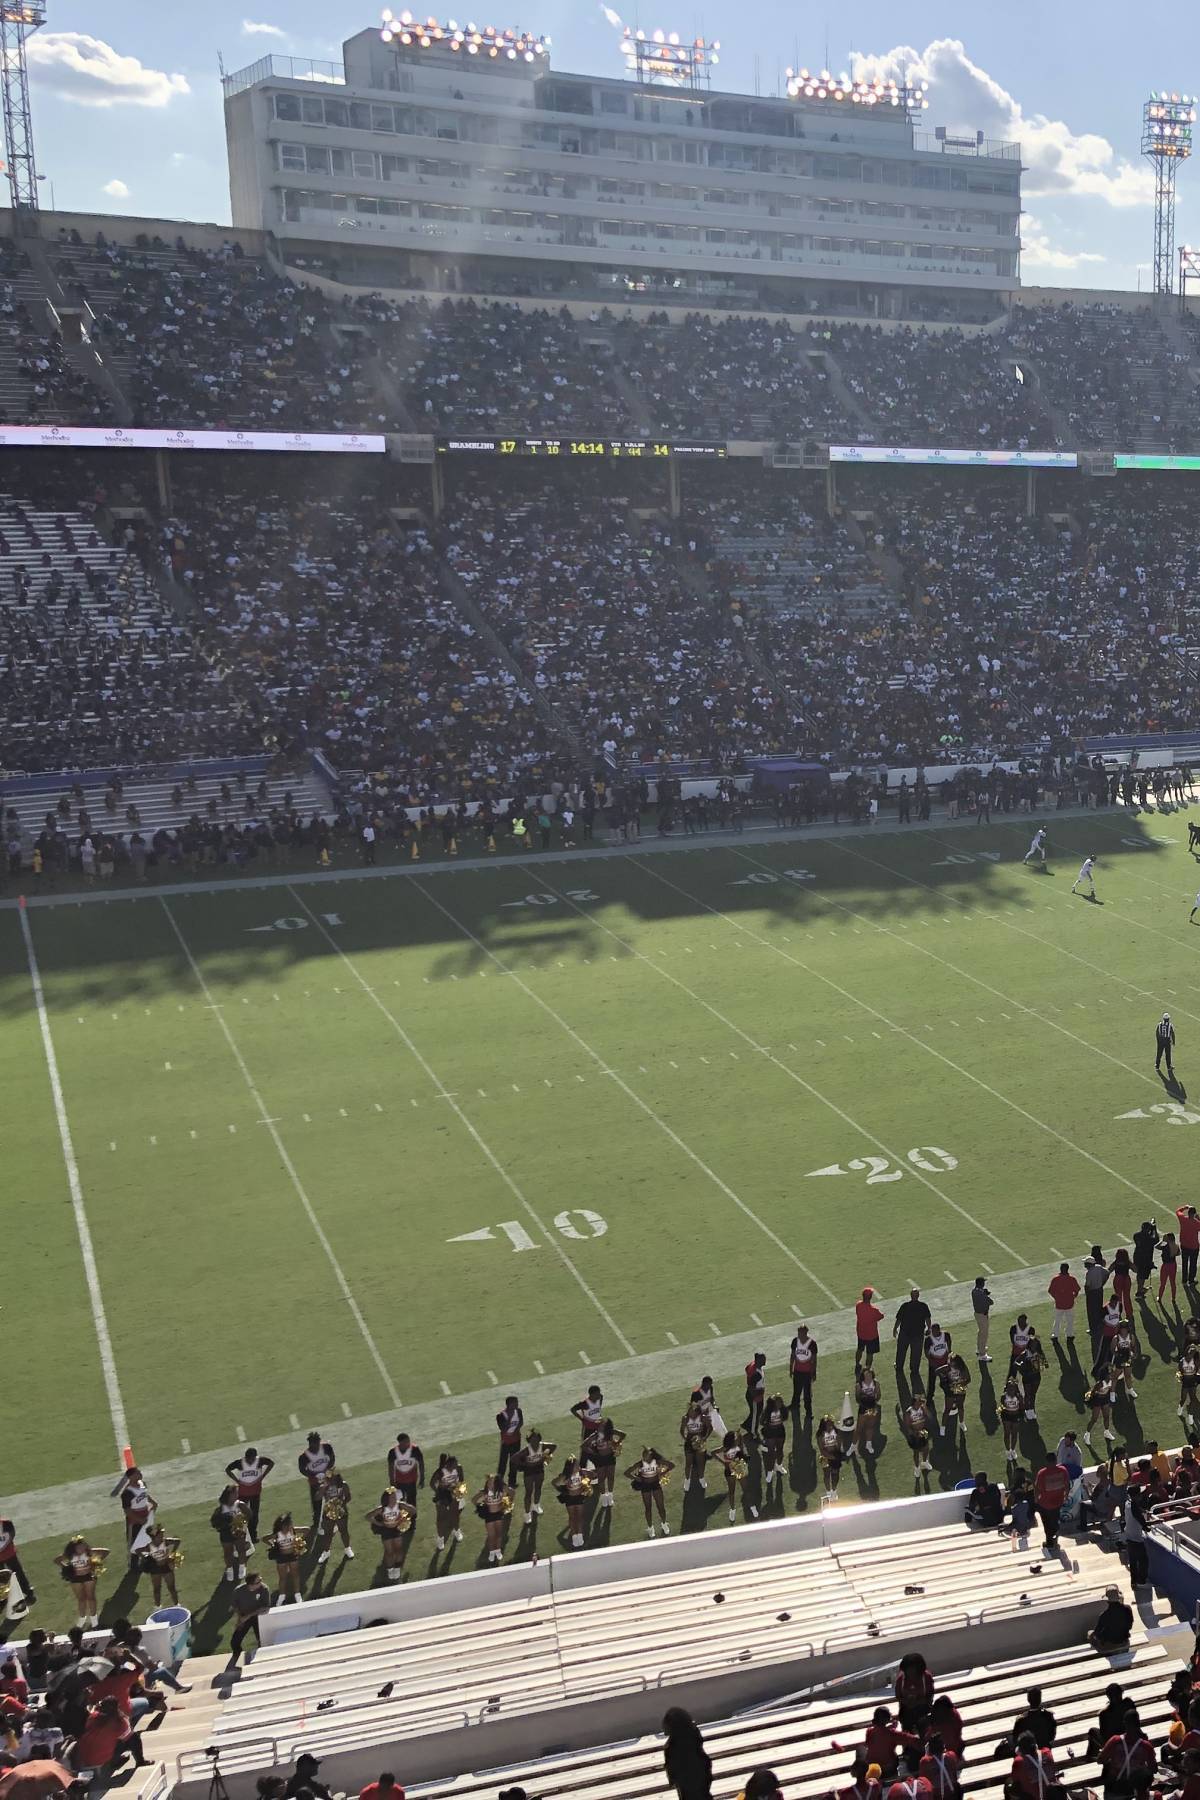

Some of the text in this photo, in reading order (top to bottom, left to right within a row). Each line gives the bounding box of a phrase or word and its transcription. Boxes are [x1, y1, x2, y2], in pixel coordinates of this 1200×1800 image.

[449, 442, 494, 450] GRAMBLING
[501, 441, 515, 452] 17
[531, 446, 537, 454] 1
[547, 446, 558, 454] 10
[571, 443, 604, 454] 14:14
[613, 447, 620, 455] 2
[654, 445, 668, 455] 14
[848, 1146, 958, 1184] 20
[496, 1209, 608, 1252] 10
